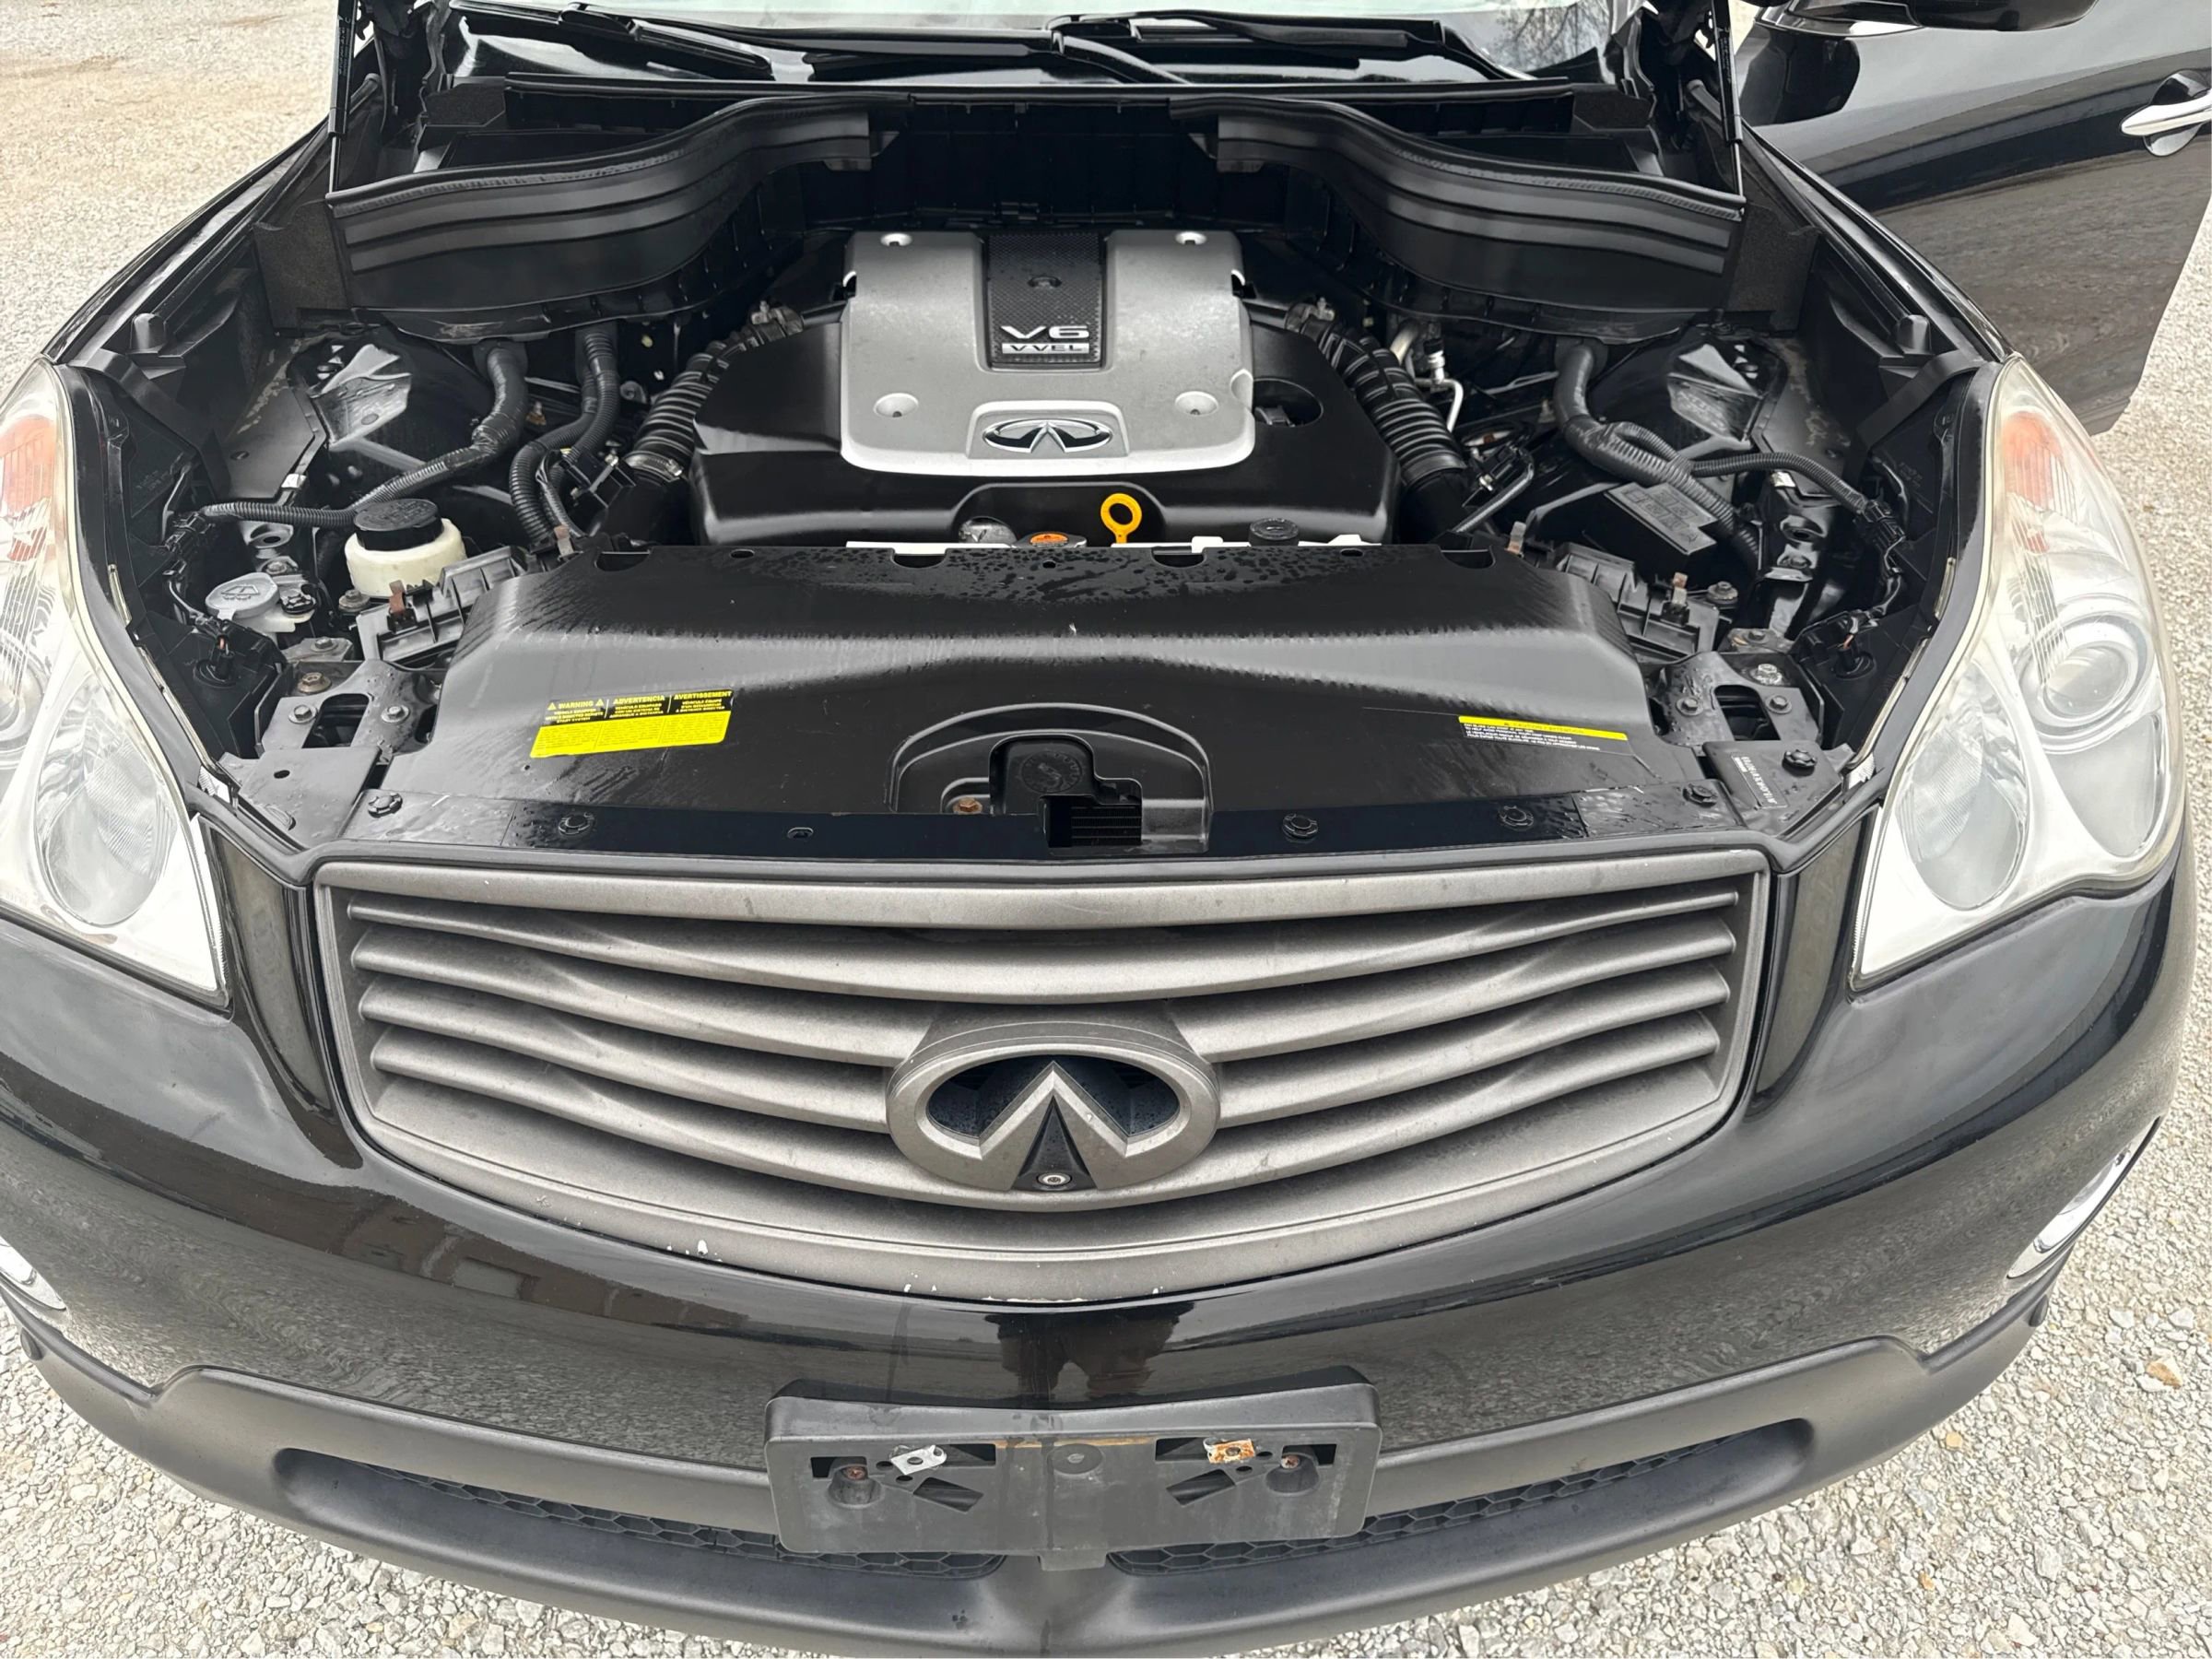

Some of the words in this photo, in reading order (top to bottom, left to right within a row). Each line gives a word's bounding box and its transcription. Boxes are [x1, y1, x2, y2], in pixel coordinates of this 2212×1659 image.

[1000, 325, 1089, 339] V6
[1009, 344, 1084, 352] VVEL
[613, 695, 665, 705] ADVERTENCIA
[674, 690, 733, 700] AVERTISSEMENT
[558, 700, 594, 710] WARNING
